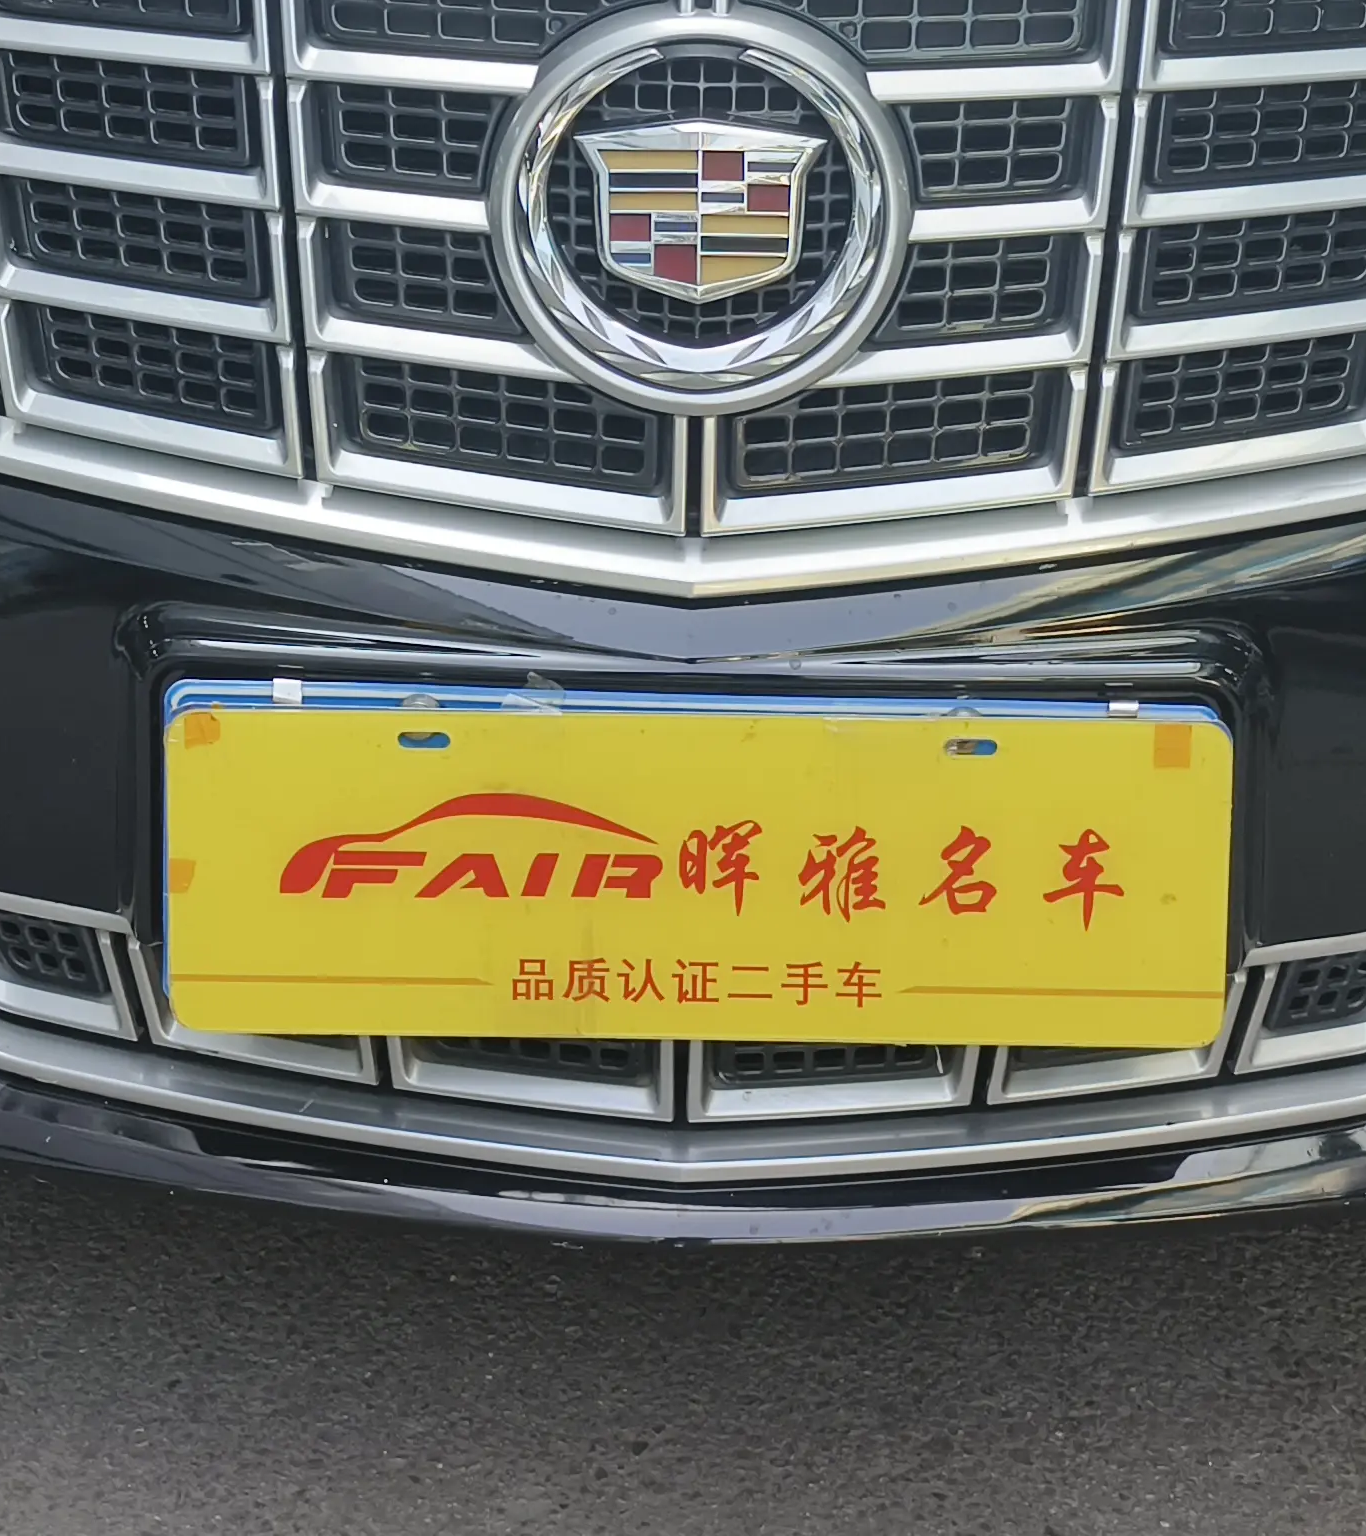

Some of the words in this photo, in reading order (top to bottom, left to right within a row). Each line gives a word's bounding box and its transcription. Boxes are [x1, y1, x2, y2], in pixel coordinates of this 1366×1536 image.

[319, 849, 664, 900] FAIR
[678, 821, 1126, 931] 晖雅名车
[510, 958, 884, 1009] 品质认证二手车
